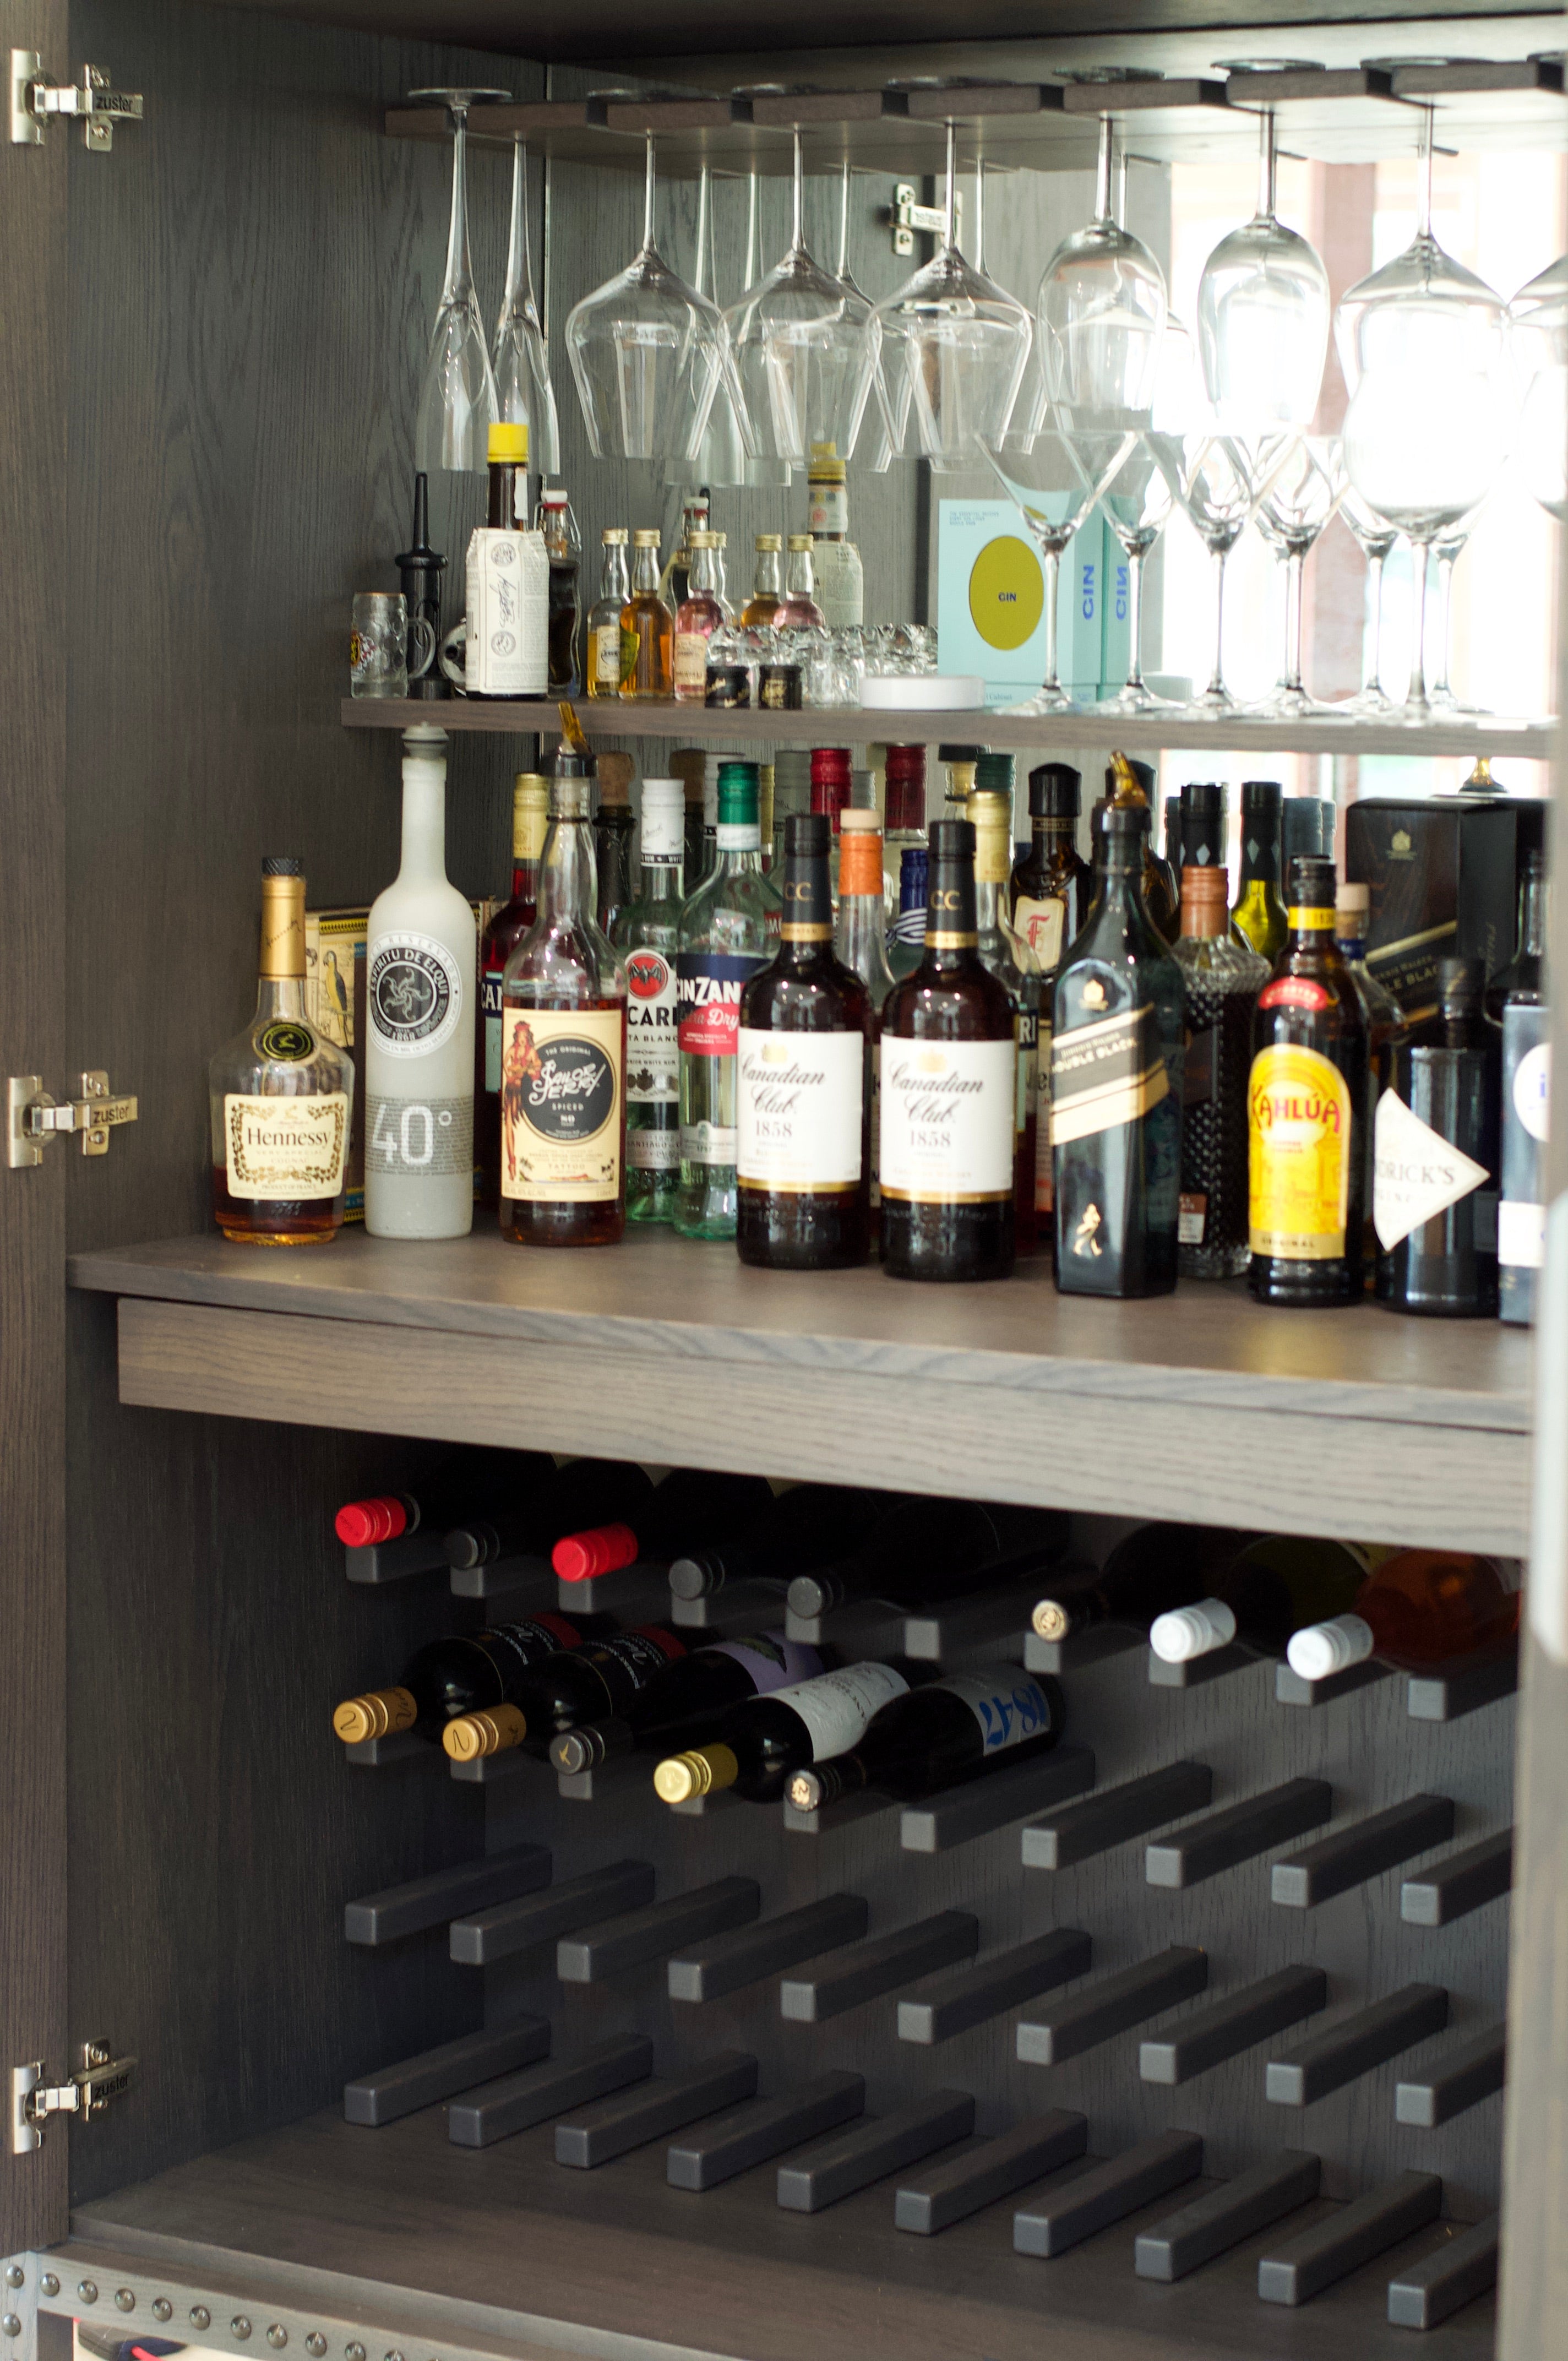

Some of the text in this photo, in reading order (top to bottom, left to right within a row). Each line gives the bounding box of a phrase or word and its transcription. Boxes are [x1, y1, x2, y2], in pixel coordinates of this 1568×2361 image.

[998, 592, 1017, 602] GIN
[1082, 565, 1095, 620] GIN
[784, 882, 812, 902] CC
[930, 889, 961, 911] CC
[371, 948, 449, 995] ESPIRITU DE ELQUI
[1405, 964, 1439, 986] BLAC
[677, 976, 741, 1007] CINZAN
[706, 1007, 739, 1032] Dry
[1095, 1036, 1137, 1060] BLACK
[740, 1053, 825, 1085] Canadian
[889, 1059, 984, 1094] Canadian
[552, 1103, 585, 1111] SPICED
[751, 1085, 801, 1114] Club
[903, 1094, 961, 1123] Club
[1253, 1084, 1341, 1134] KAHLÚA
[248, 1127, 331, 1150] Hennessy
[756, 1119, 793, 1139] 1858
[910, 1130, 952, 1148] 1858
[1376, 1158, 1456, 1185] DRICK'S
